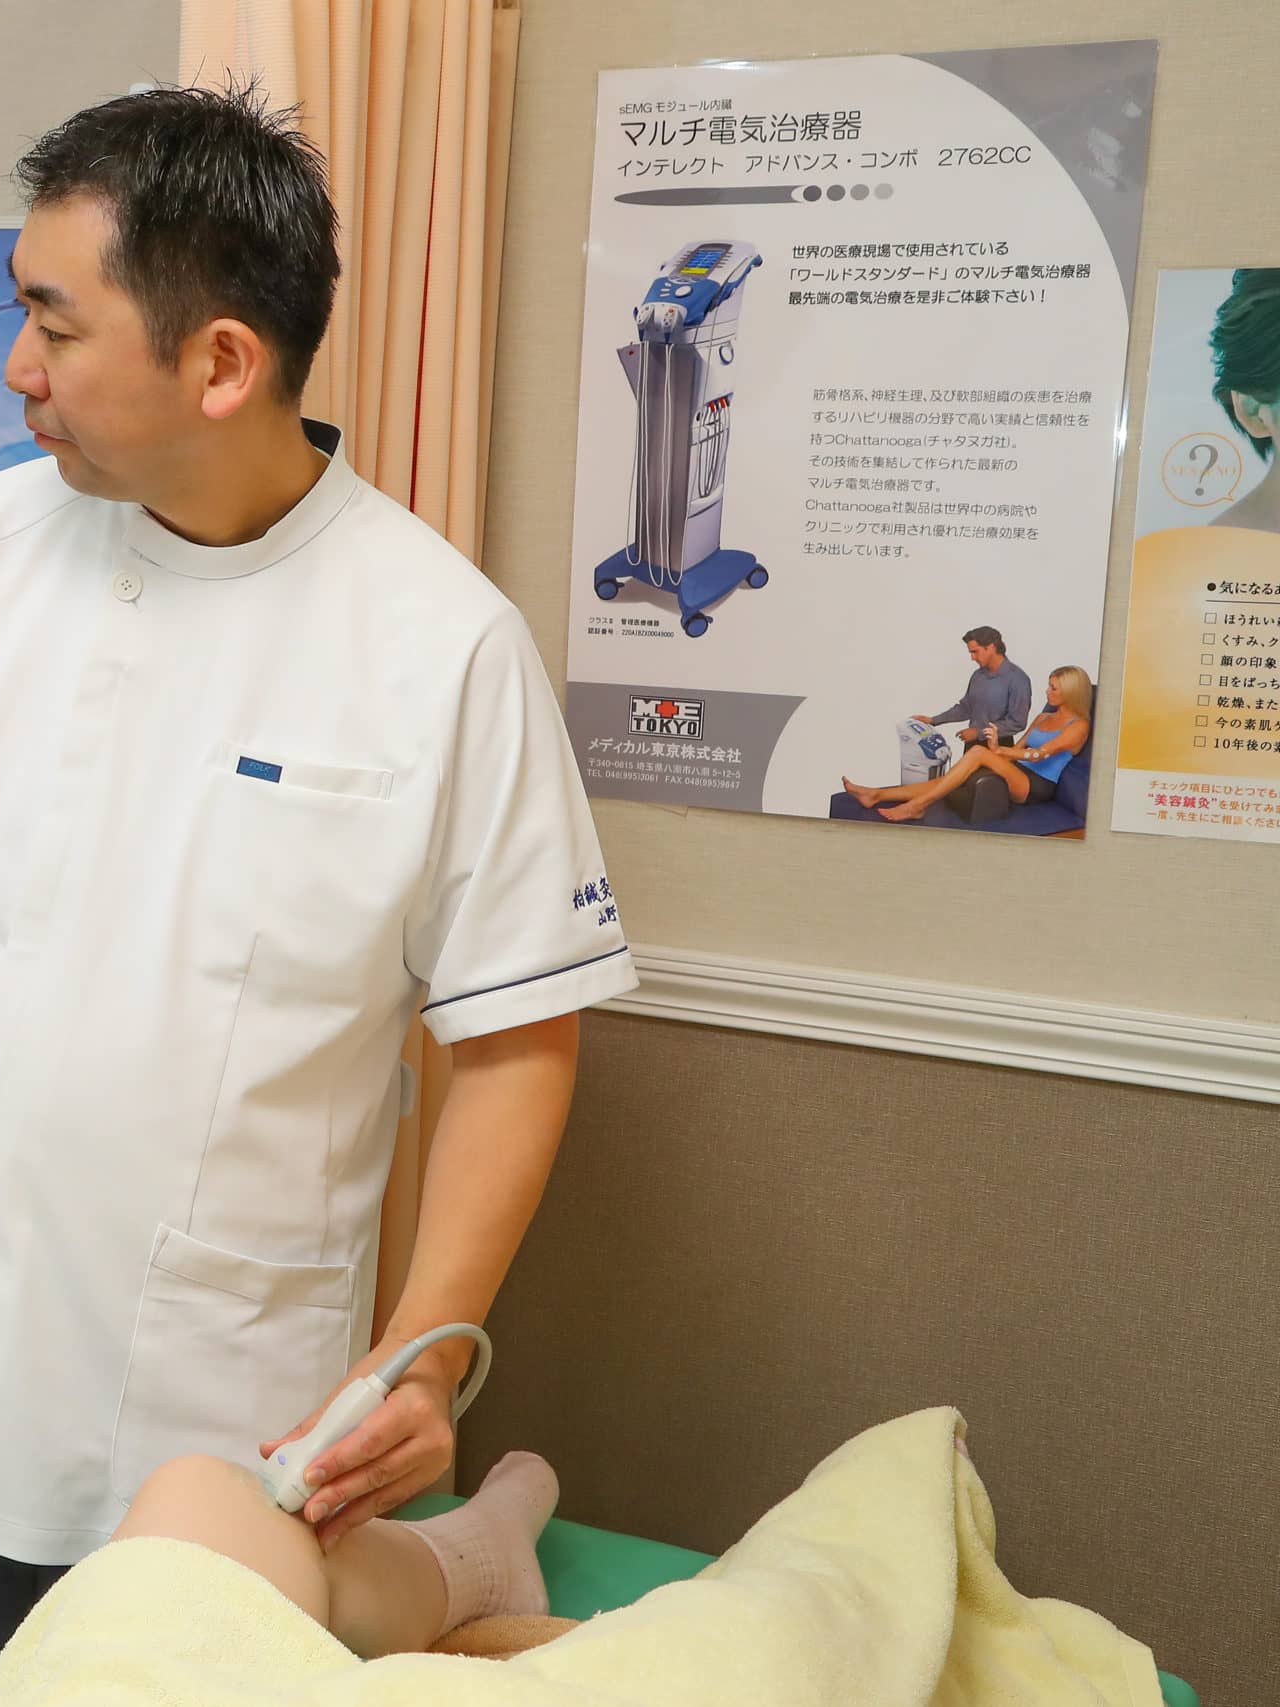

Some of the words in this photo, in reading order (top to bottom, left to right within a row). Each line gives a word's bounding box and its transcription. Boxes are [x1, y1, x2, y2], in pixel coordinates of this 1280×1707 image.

[619, 102, 652, 114] sEMG
[620, 110, 862, 146] マルチ電気治療器
[618, 156, 724, 176] インテレクト
[938, 146, 1032, 167] 2762CC
[792, 241, 1009, 259] 世界の医療現場で使用されている
[790, 263, 1091, 282] 「ワールドスタンダード」のマルチ電気治療器
[788, 289, 1046, 305] 最先端の電気治療を是非ご体験下さい！
[812, 411, 1090, 427] するリハビリ機器の分野で高い実績と信頼性を
[808, 455, 1018, 472] その技術を集結して作られた最新の
[807, 477, 941, 493] マルチ電気治療器です。
[805, 520, 1039, 540] クリニックで利用され優れた治療効果を
[803, 542, 910, 558] 生み出しています。
[1224, 613, 1280, 626] ほうれい
[1220, 654, 1278, 669] 顔の印象
[633, 717, 698, 736] TOKYO
[588, 738, 742, 763] メディカル東京株式会社
[587, 768, 602, 777] TEL
[665, 775, 682, 785] FAX
[1150, 780, 1280, 799] チェック項目にひとつでも
